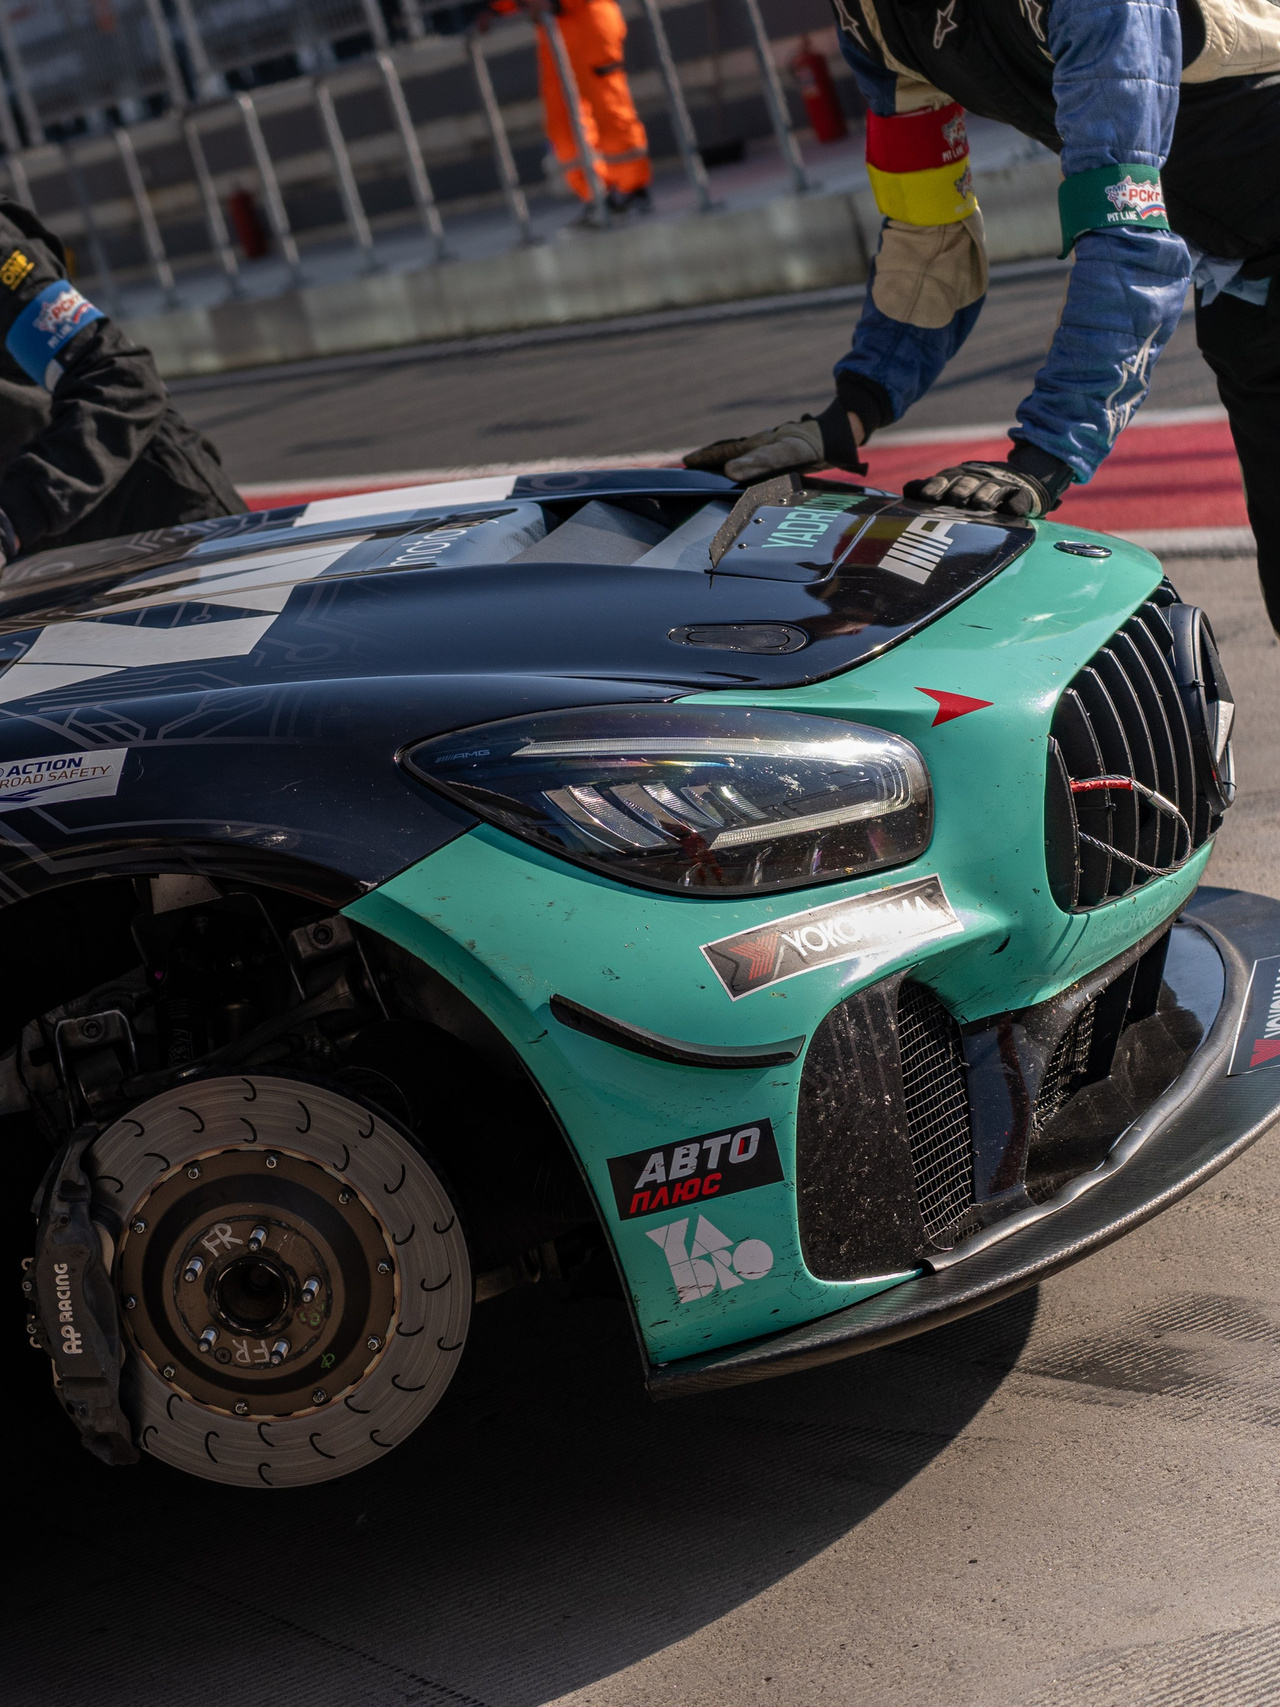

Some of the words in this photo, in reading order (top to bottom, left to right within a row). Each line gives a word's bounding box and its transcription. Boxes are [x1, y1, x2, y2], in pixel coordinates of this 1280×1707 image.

[1106, 212, 1119, 222] PIT
[1120, 210, 1138, 220] LANE
[0, 773, 44, 789] ROAD
[48, 765, 112, 782] SAFETY
[6, 757, 83, 777] ACTION
[781, 896, 934, 957] YOKOA
[629, 1172, 722, 1214] ПЛЮС
[201, 1223, 243, 1257] FR
[53, 1263, 74, 1322] RACING
[62, 1324, 83, 1354] AP
